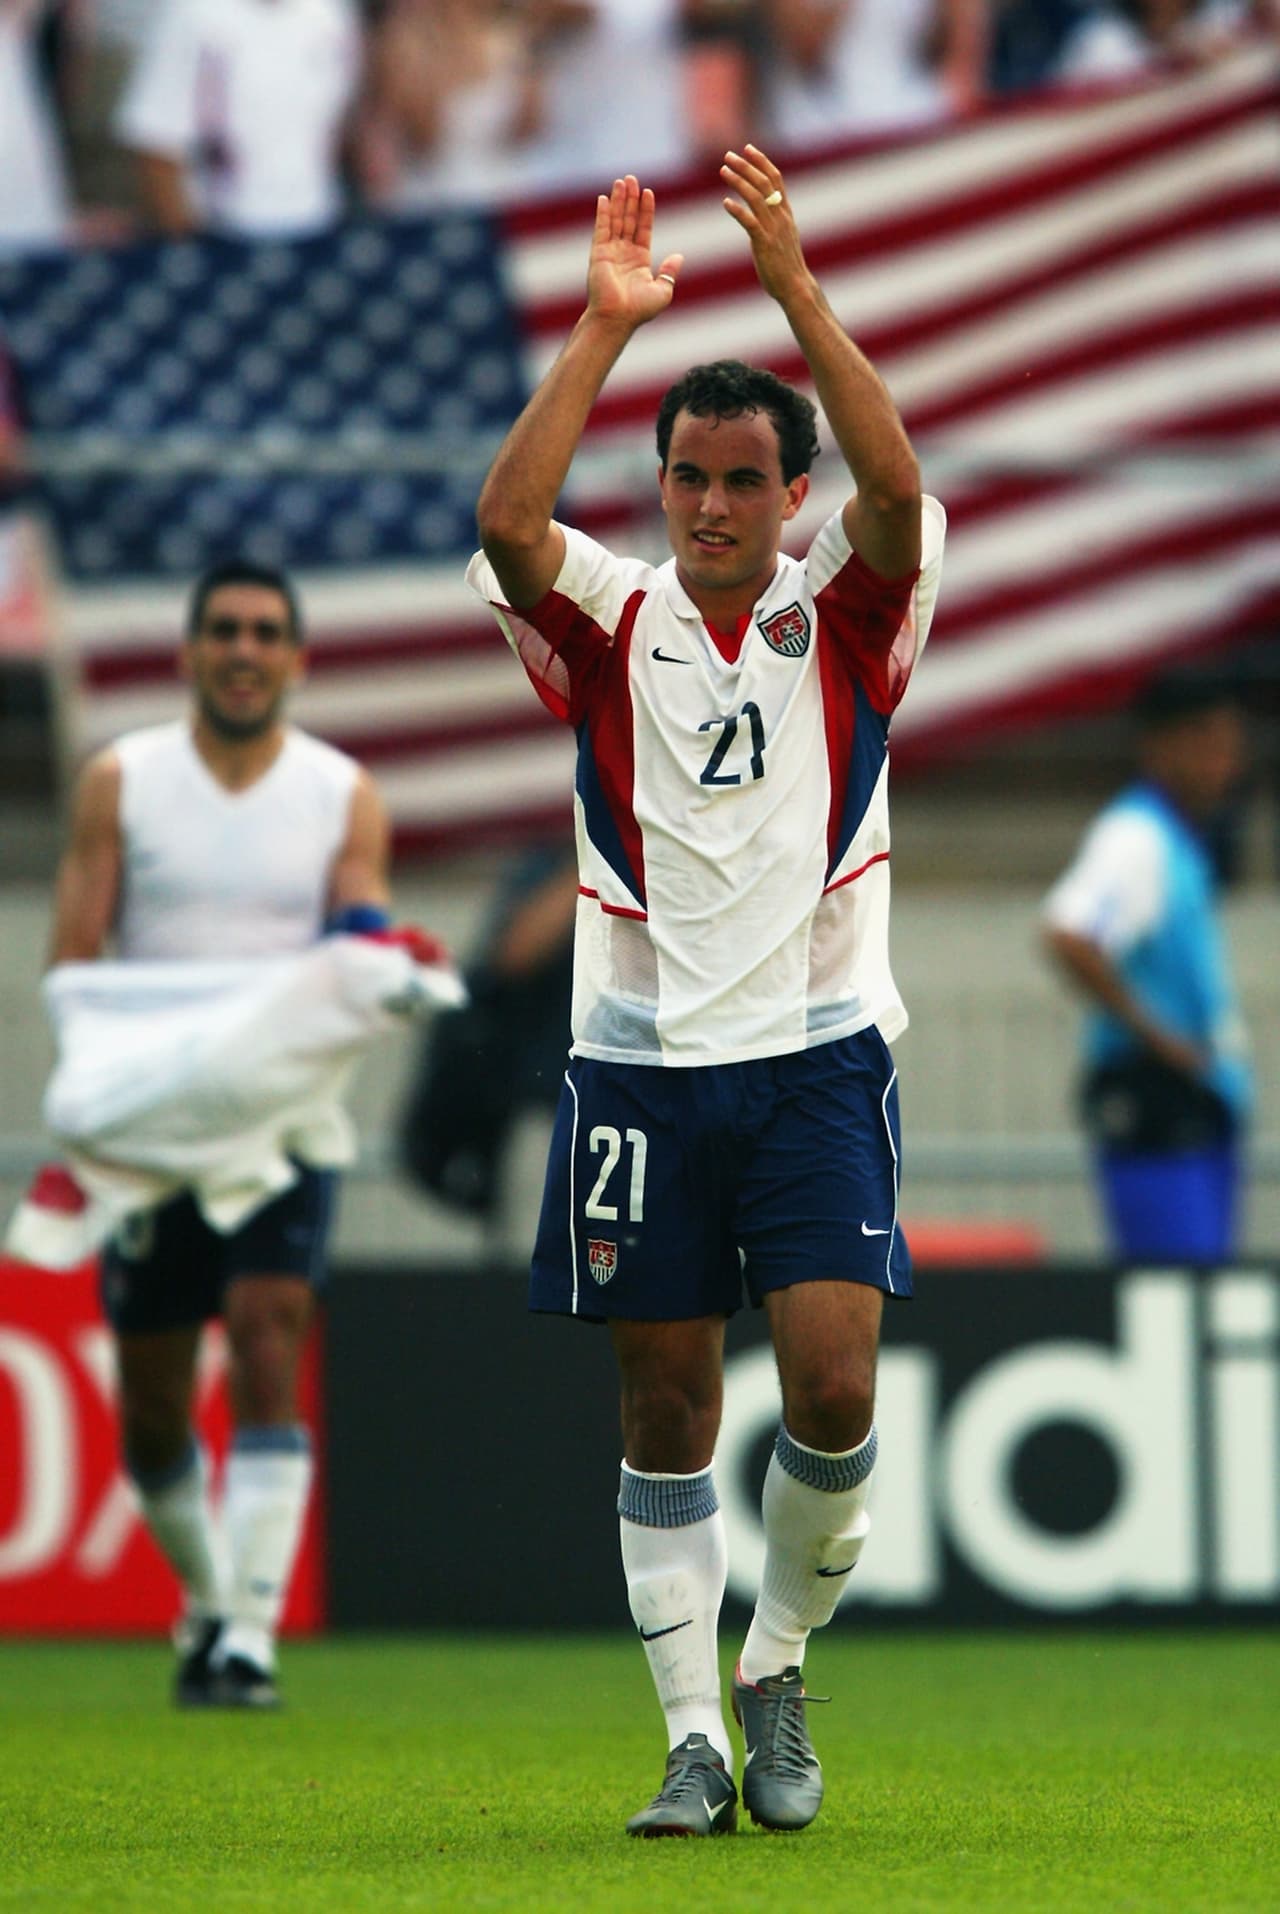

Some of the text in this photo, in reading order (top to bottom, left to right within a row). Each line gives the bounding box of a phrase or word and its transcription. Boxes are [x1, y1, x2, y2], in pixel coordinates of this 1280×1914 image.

[698, 701, 766, 785] 21
[585, 1125, 648, 1222] 21
[716, 1271, 1280, 1608] adi
